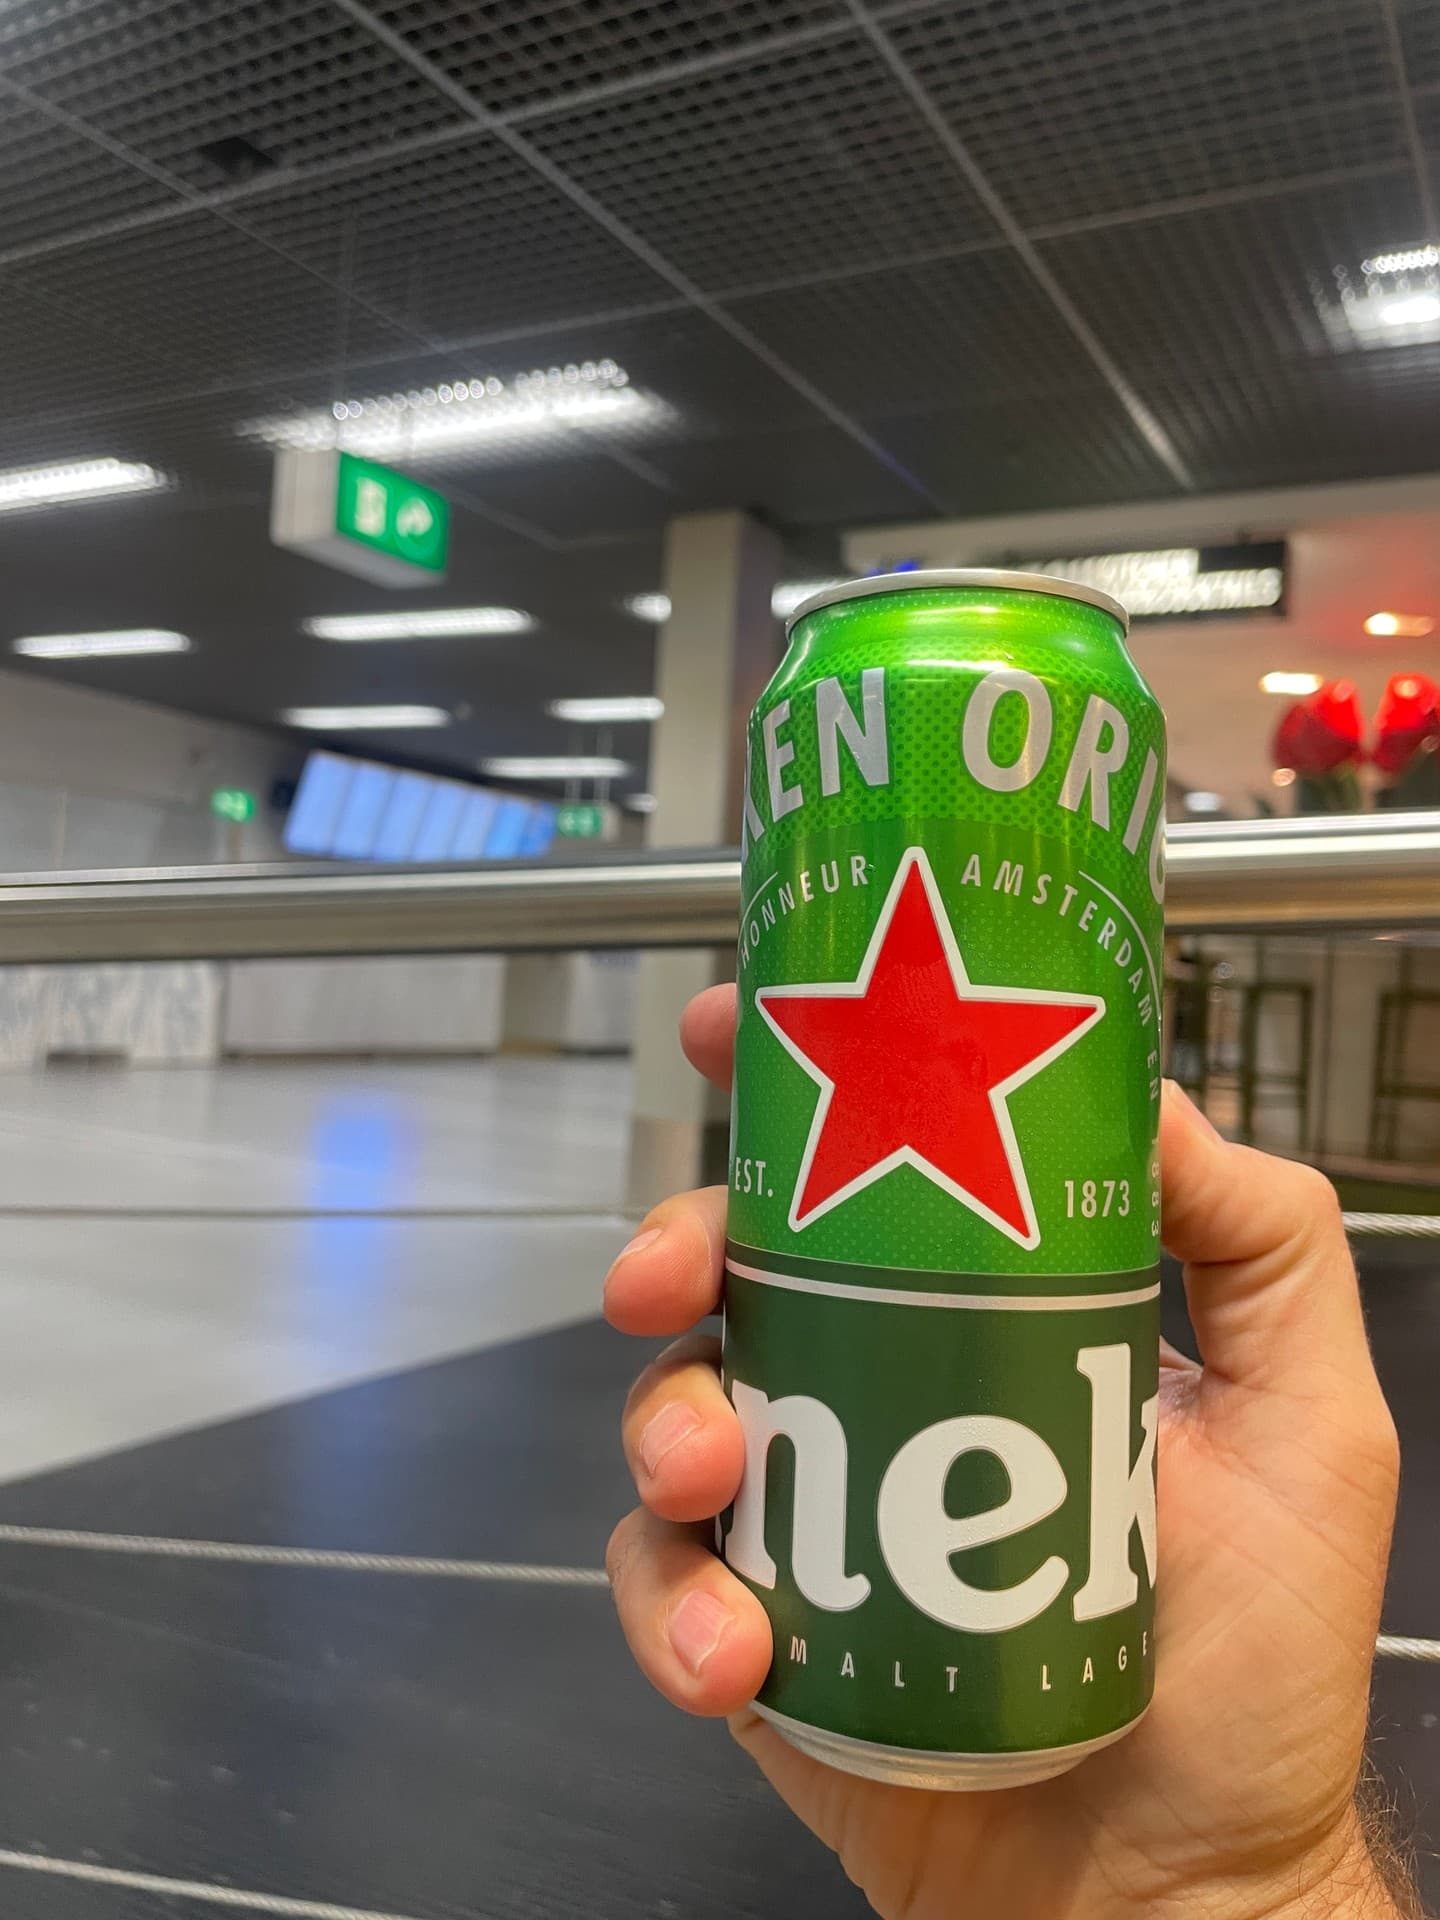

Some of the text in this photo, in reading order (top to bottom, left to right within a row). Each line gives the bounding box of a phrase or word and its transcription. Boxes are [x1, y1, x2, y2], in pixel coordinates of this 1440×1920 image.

[740, 854, 869, 970] HONNEUR
[961, 853, 1153, 1027] AMSTERDAM
[734, 1156, 1131, 1218] EST. 1873
[716, 1342, 1159, 1634] nek
[790, 1636, 960, 1693] MALT
